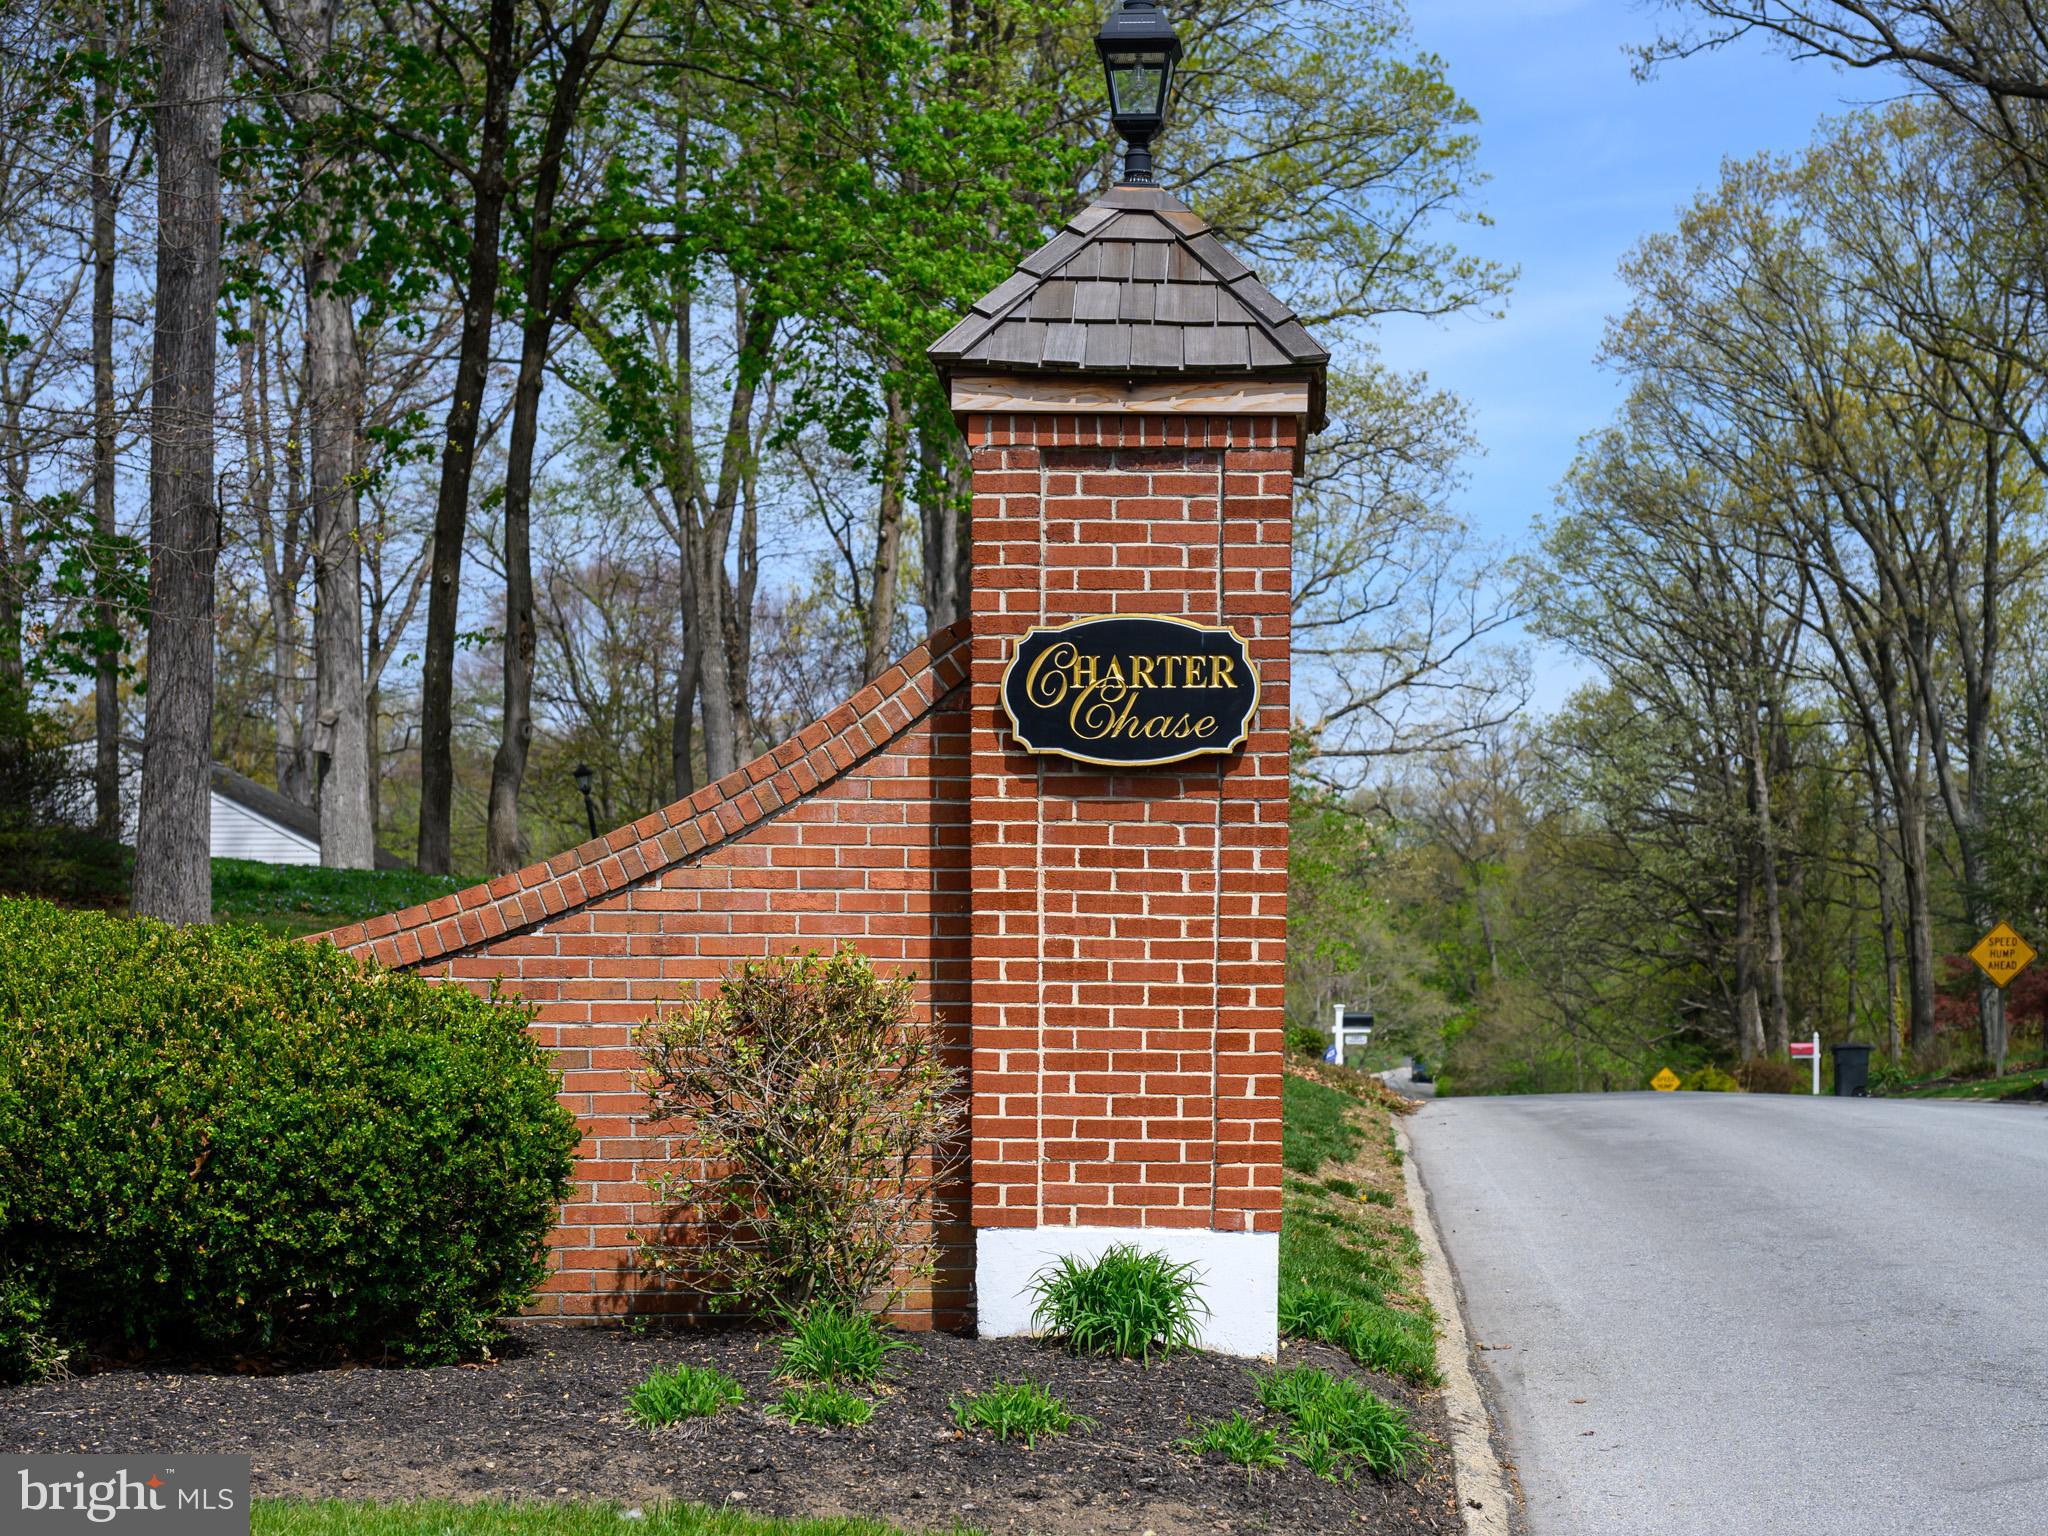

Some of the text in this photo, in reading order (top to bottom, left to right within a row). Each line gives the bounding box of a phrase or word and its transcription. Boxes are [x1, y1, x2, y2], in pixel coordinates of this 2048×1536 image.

[1026, 641, 1239, 708] CHARTER
[1069, 676, 1219, 740] Chase
[1988, 937, 2018, 947] SPEED
[1989, 949, 2016, 958] HUMP
[1988, 960, 2018, 970] AHEAD
